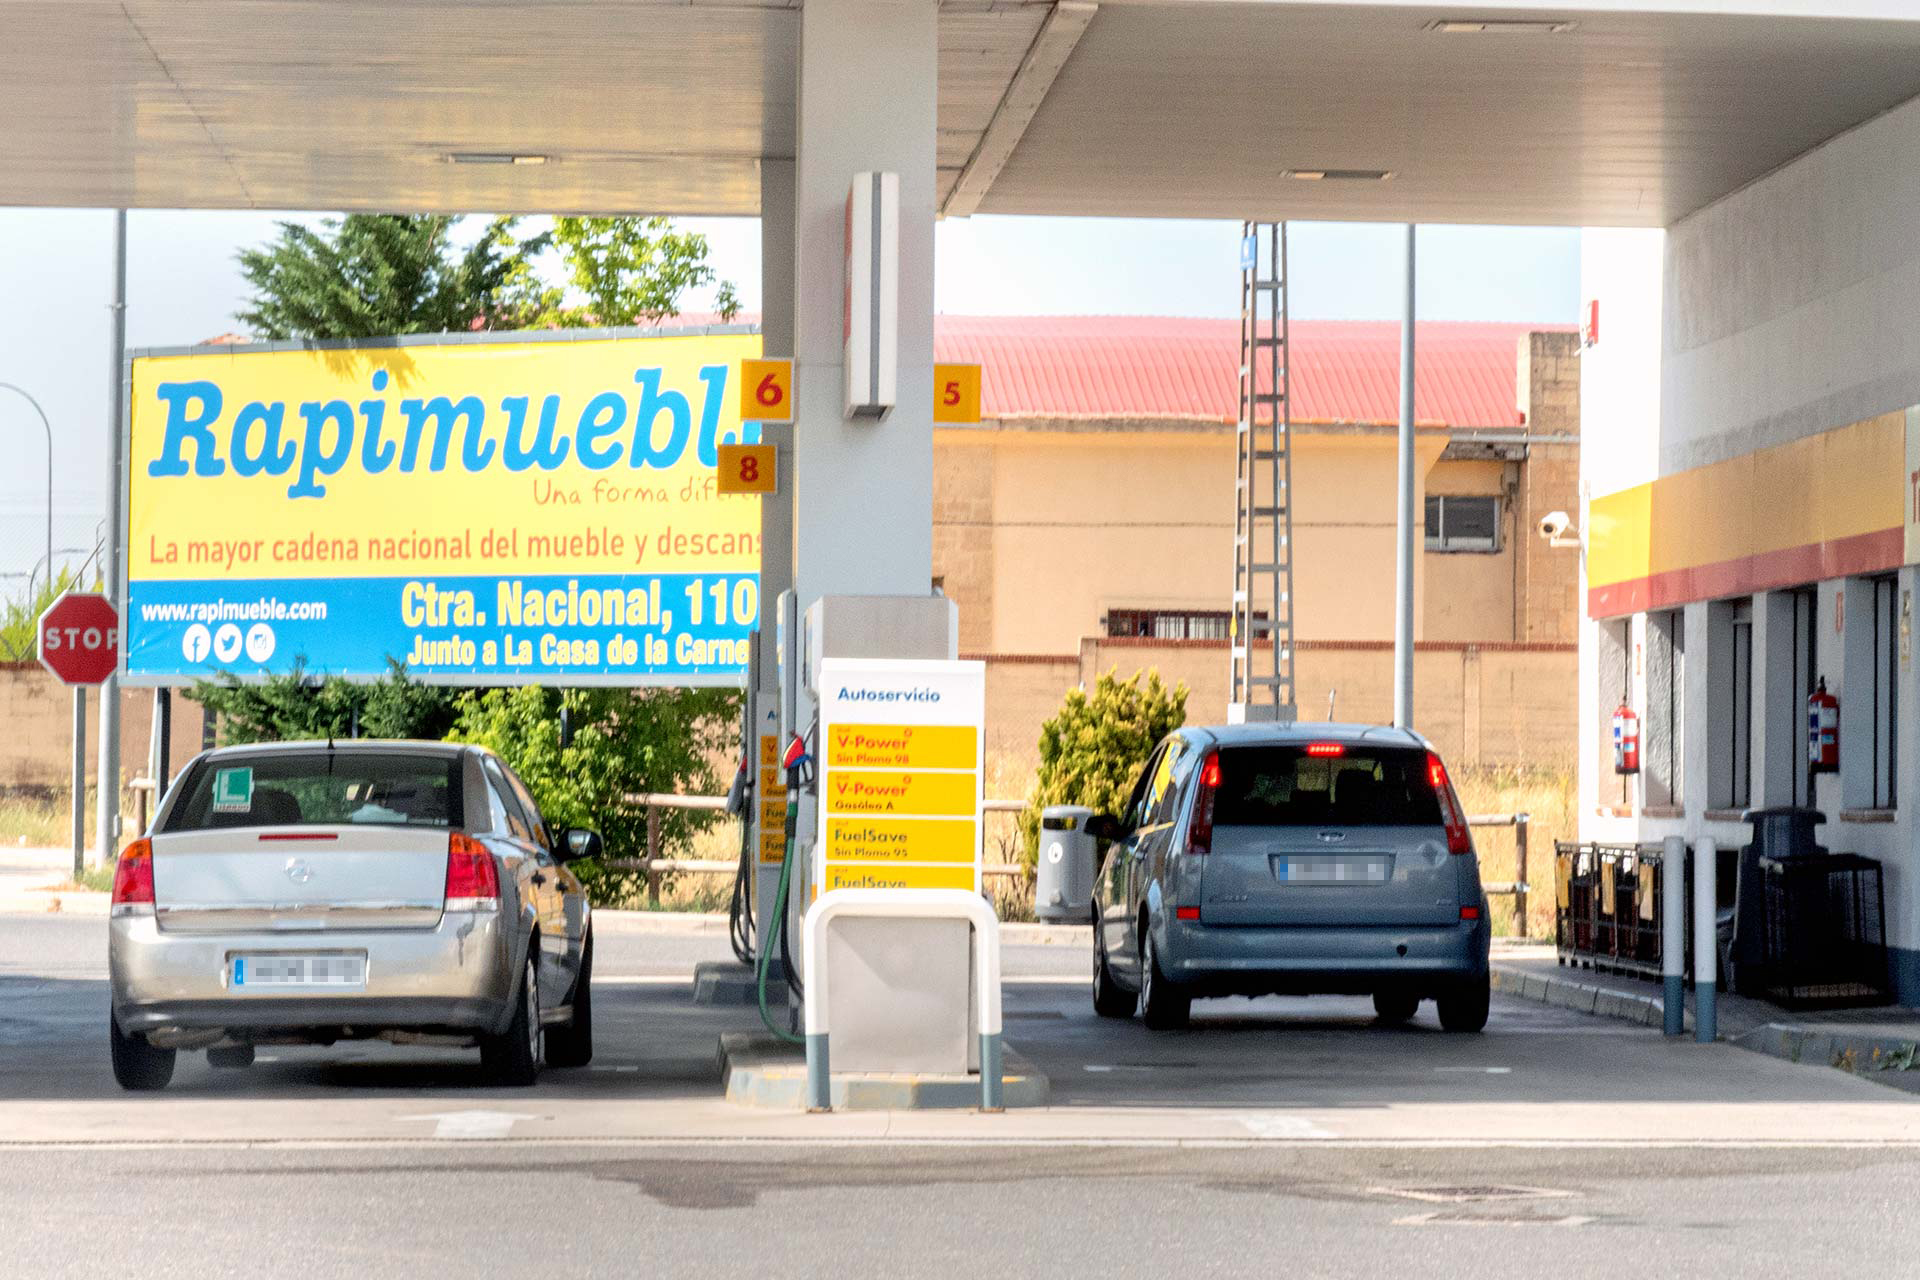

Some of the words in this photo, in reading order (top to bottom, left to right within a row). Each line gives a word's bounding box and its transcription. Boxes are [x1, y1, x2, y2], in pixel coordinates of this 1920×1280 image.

[756, 373, 783, 406] 6
[944, 382, 961, 406] 5
[148, 365, 761, 499] Rapimuebl
[739, 455, 759, 483] 8
[534, 478, 581, 506] Una
[593, 477, 668, 504] forma
[150, 534, 178, 564] La
[187, 538, 264, 571] mayor
[272, 531, 359, 562] cadena
[368, 528, 470, 561] nacional
[480, 528, 518, 558] del
[528, 526, 624, 558] mueble
[635, 533, 648, 565] y
[402, 581, 486, 627] Ctra.
[497, 579, 673, 634] Nacional,
[685, 578, 758, 626] 110
[407, 634, 476, 666] Junto
[482, 640, 498, 666] a
[505, 633, 533, 665] La
[540, 633, 600, 665] Casa
[607, 633, 638, 665] de
[644, 633, 669, 665] la
[675, 632, 750, 665] Carne
[837, 687, 941, 703] Autoservicio
[836, 734, 909, 750] V-Power
[836, 782, 908, 797] V-Power
[886, 801, 894, 810] A
[834, 828, 908, 843] FuelSave
[834, 874, 907, 889] FuelSave
